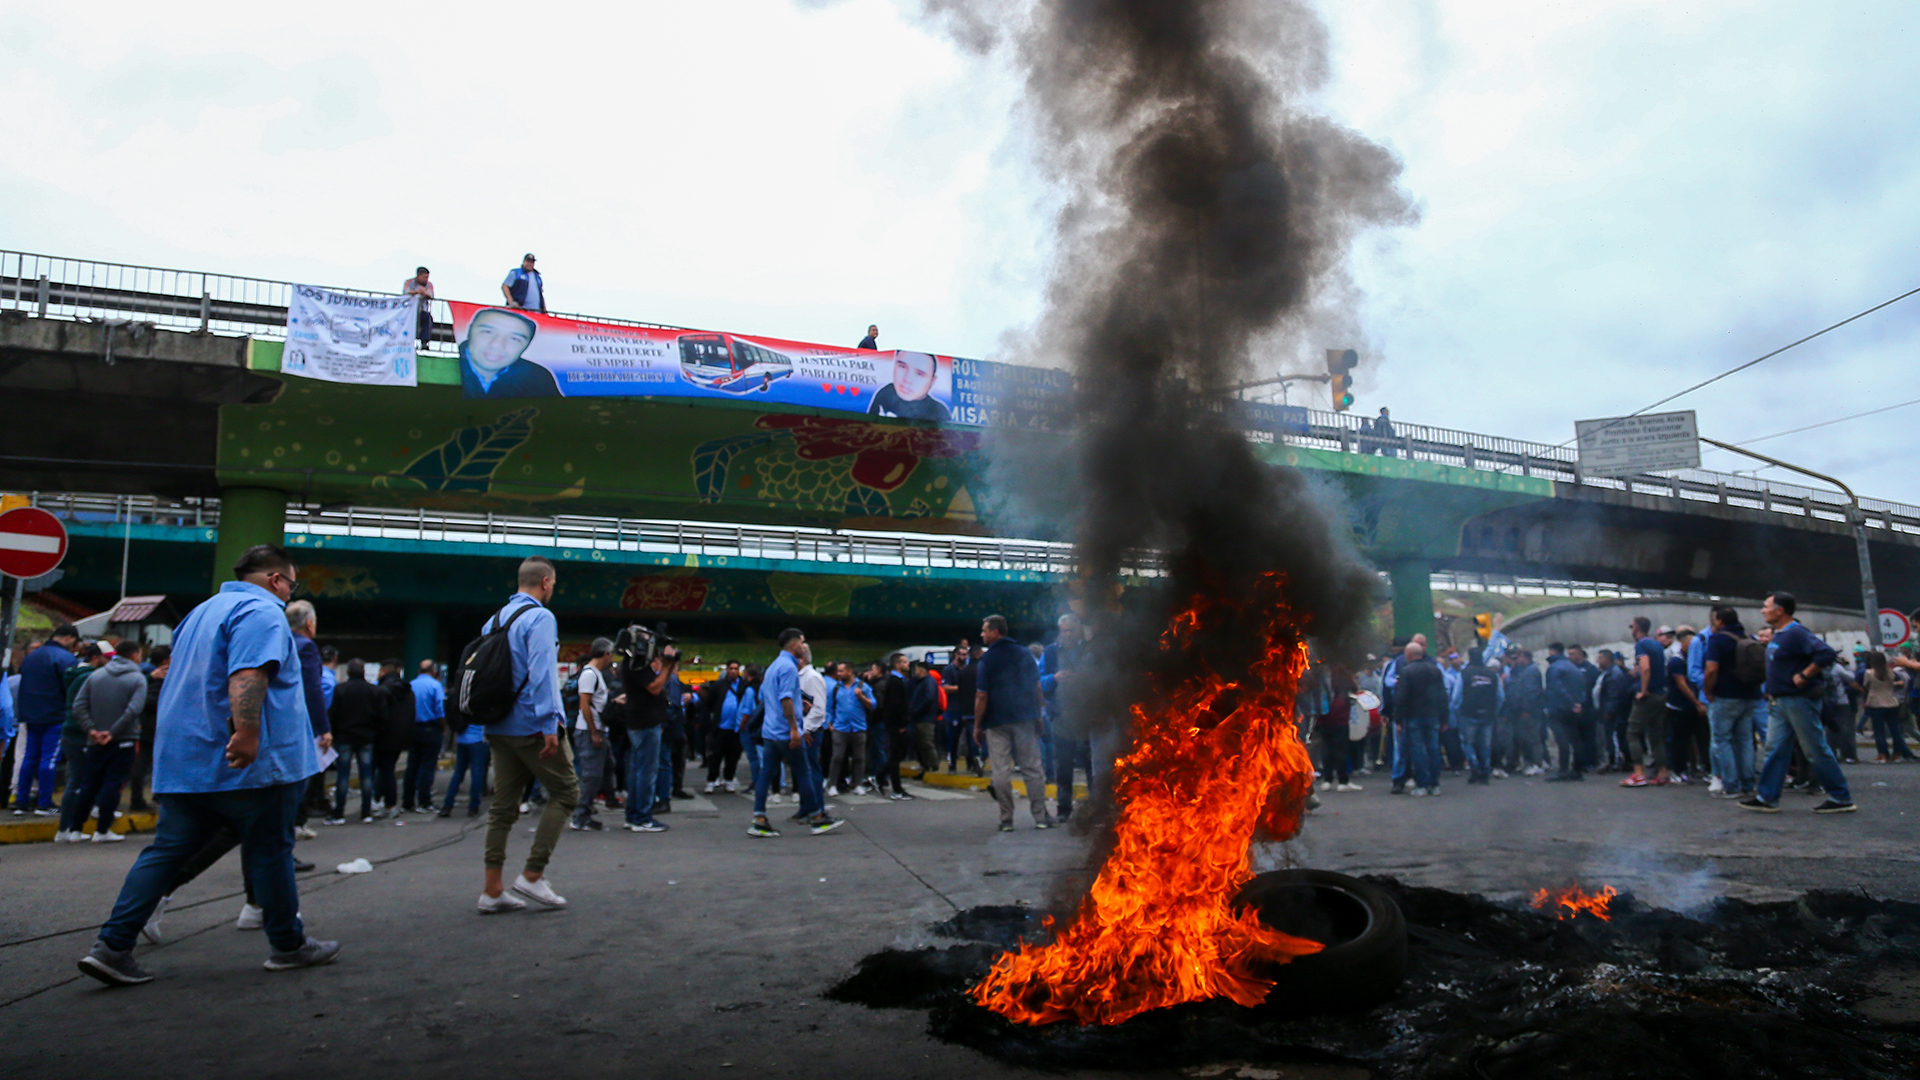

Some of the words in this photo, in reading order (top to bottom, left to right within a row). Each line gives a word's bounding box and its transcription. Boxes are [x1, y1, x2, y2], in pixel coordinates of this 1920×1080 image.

[297, 284, 323, 301] LOS
[326, 294, 387, 309] JUNIORS
[571, 344, 587, 354] DE
[588, 346, 665, 357] ALMAFUERTE
[586, 358, 635, 368] SIEMPRE
[638, 360, 653, 369] TE
[799, 356, 848, 368] JUSTICIA
[849, 360, 875, 371] PARA
[567, 371, 663, 383] RECORDAREMOS
[800, 368, 836, 380] PABLO
[838, 371, 877, 385] FLORES
[993, 364, 1061, 388] POLICIAL
[960, 392, 1001, 405] FEDERA
[1283, 411, 1306, 424] PAZ
